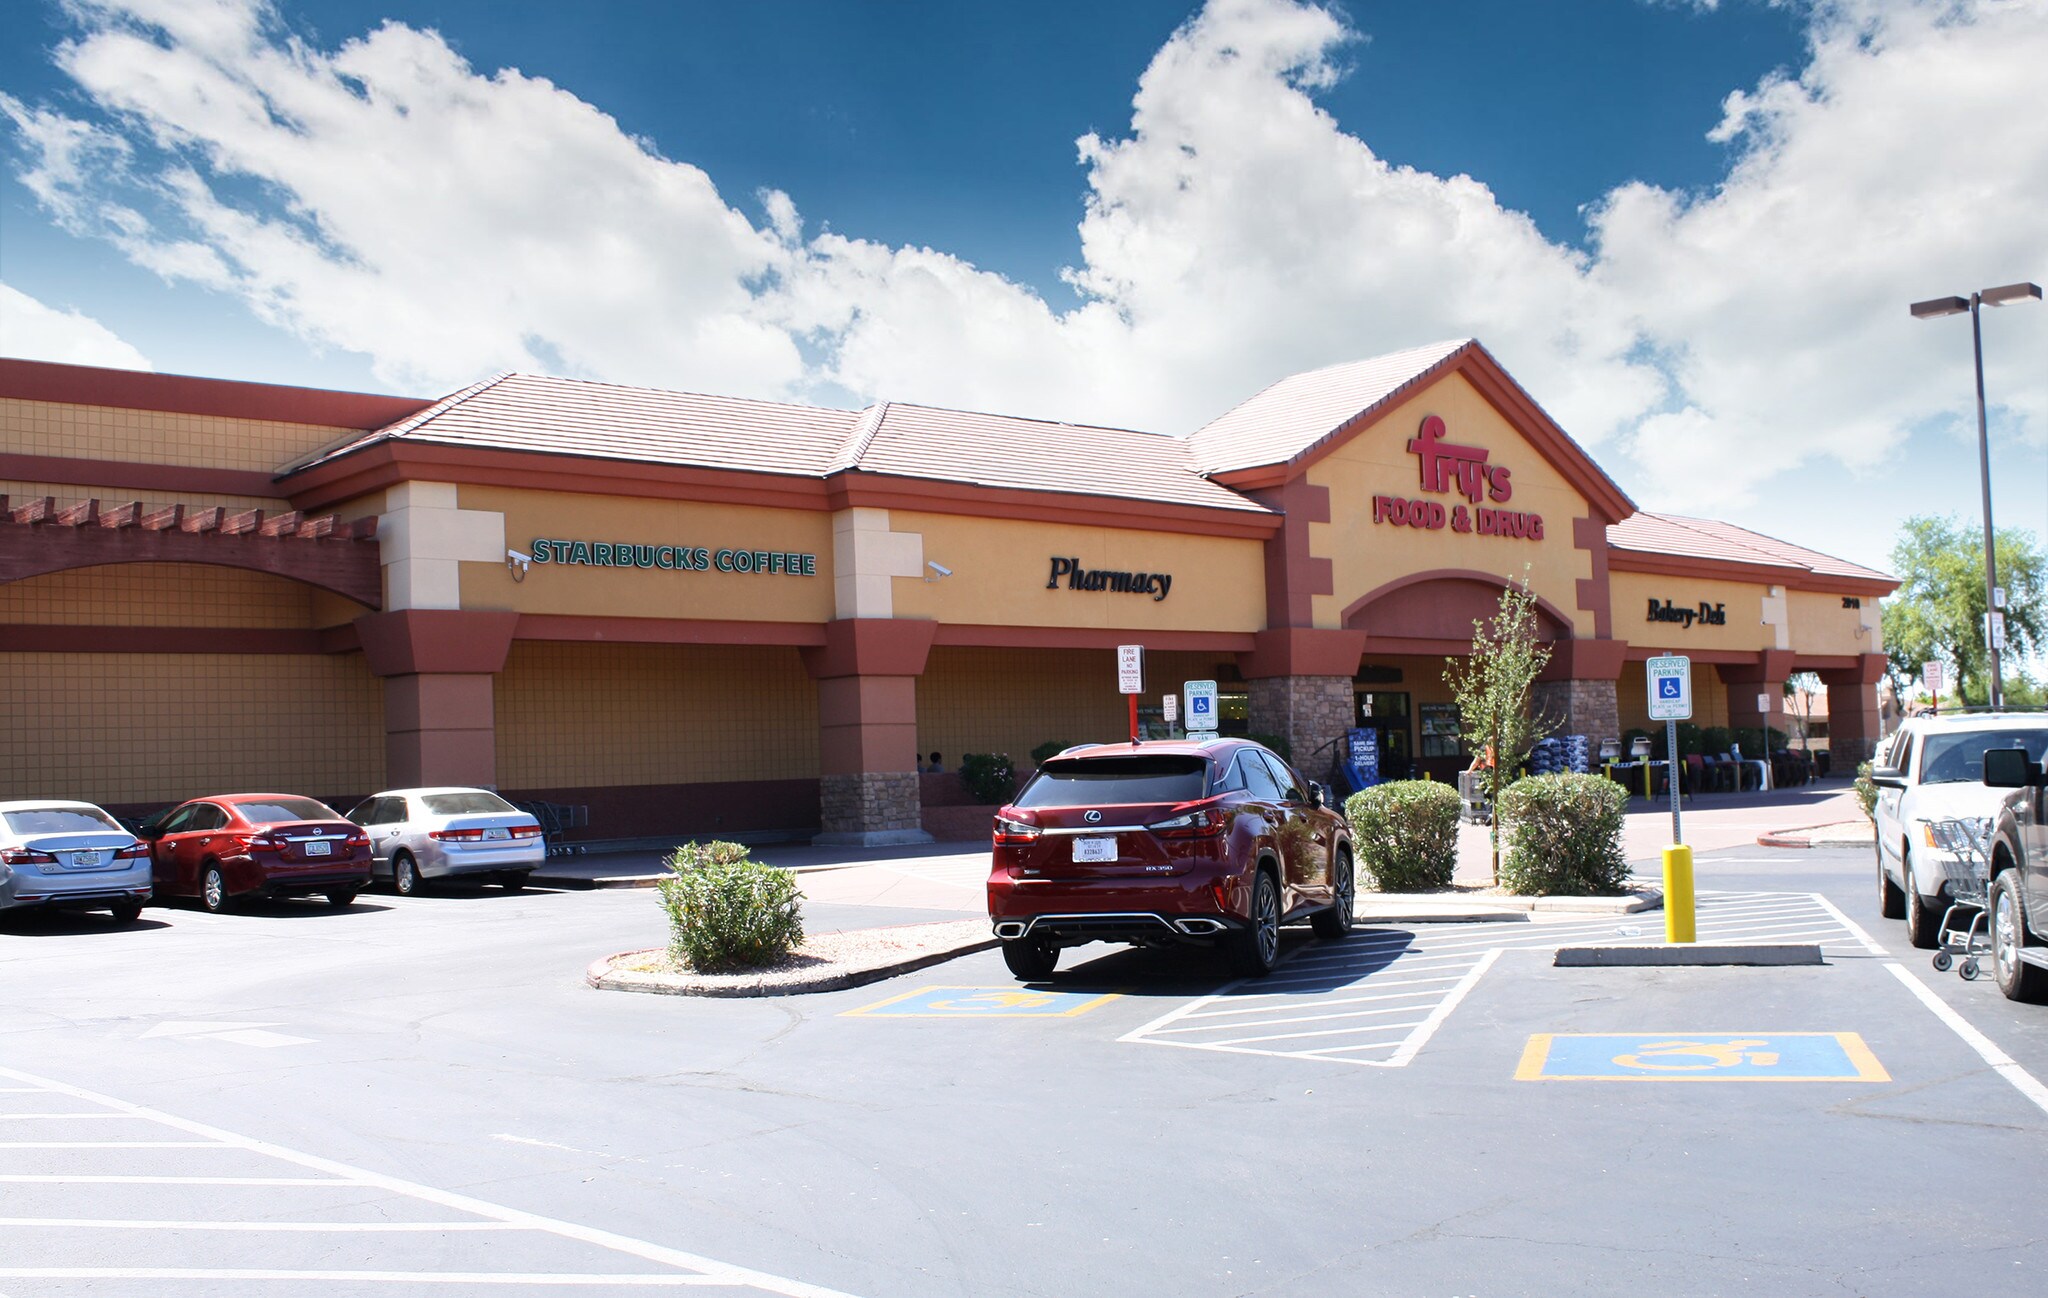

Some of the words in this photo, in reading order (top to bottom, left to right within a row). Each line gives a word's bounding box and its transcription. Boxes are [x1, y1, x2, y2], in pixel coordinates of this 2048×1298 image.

[1373, 495, 1446, 530] FOOD
[1452, 504, 1473, 533] &
[1477, 507, 1544, 541] DRUG
[533, 539, 710, 571] STARBUCKS
[714, 549, 816, 576] COFFEE
[1046, 557, 1172, 602] Pharmacy
[1650, 660, 1687, 668] RESERVED
[1653, 669, 1685, 677] PARKING
